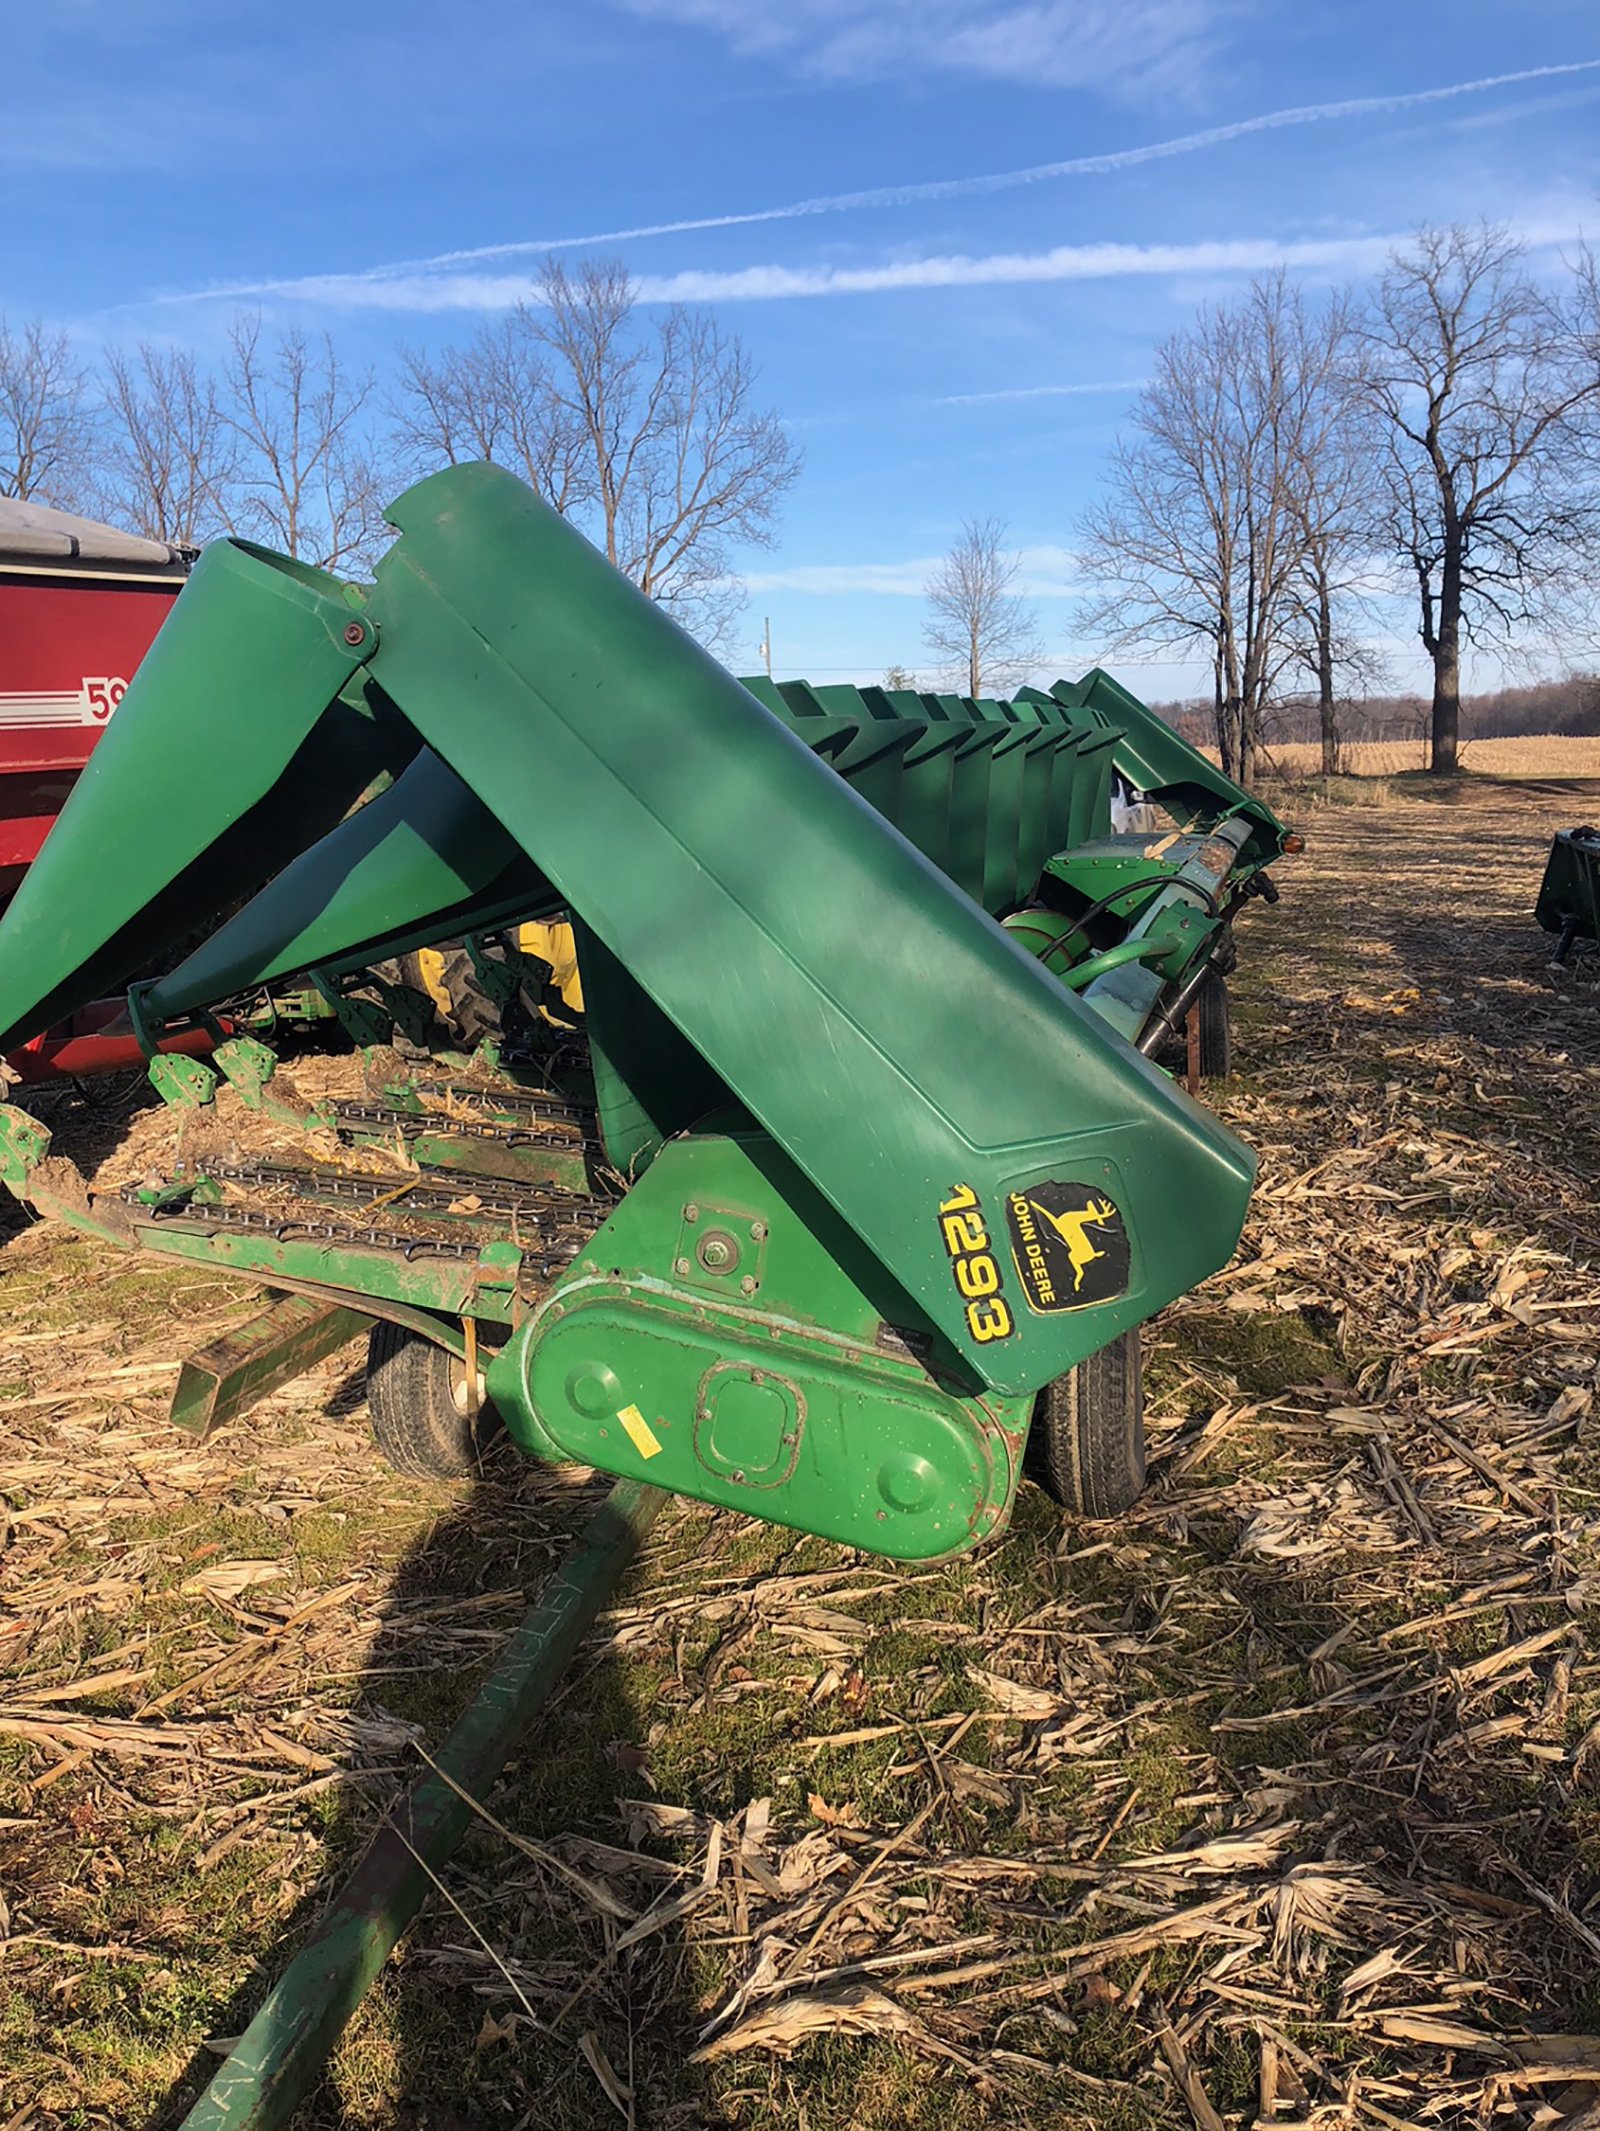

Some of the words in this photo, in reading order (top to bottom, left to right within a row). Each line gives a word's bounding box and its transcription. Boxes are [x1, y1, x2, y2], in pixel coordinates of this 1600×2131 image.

[939, 1183, 1012, 1343] 1293
[1009, 1191, 1038, 1242] JOHN
[1025, 1243, 1056, 1305] DEERE
